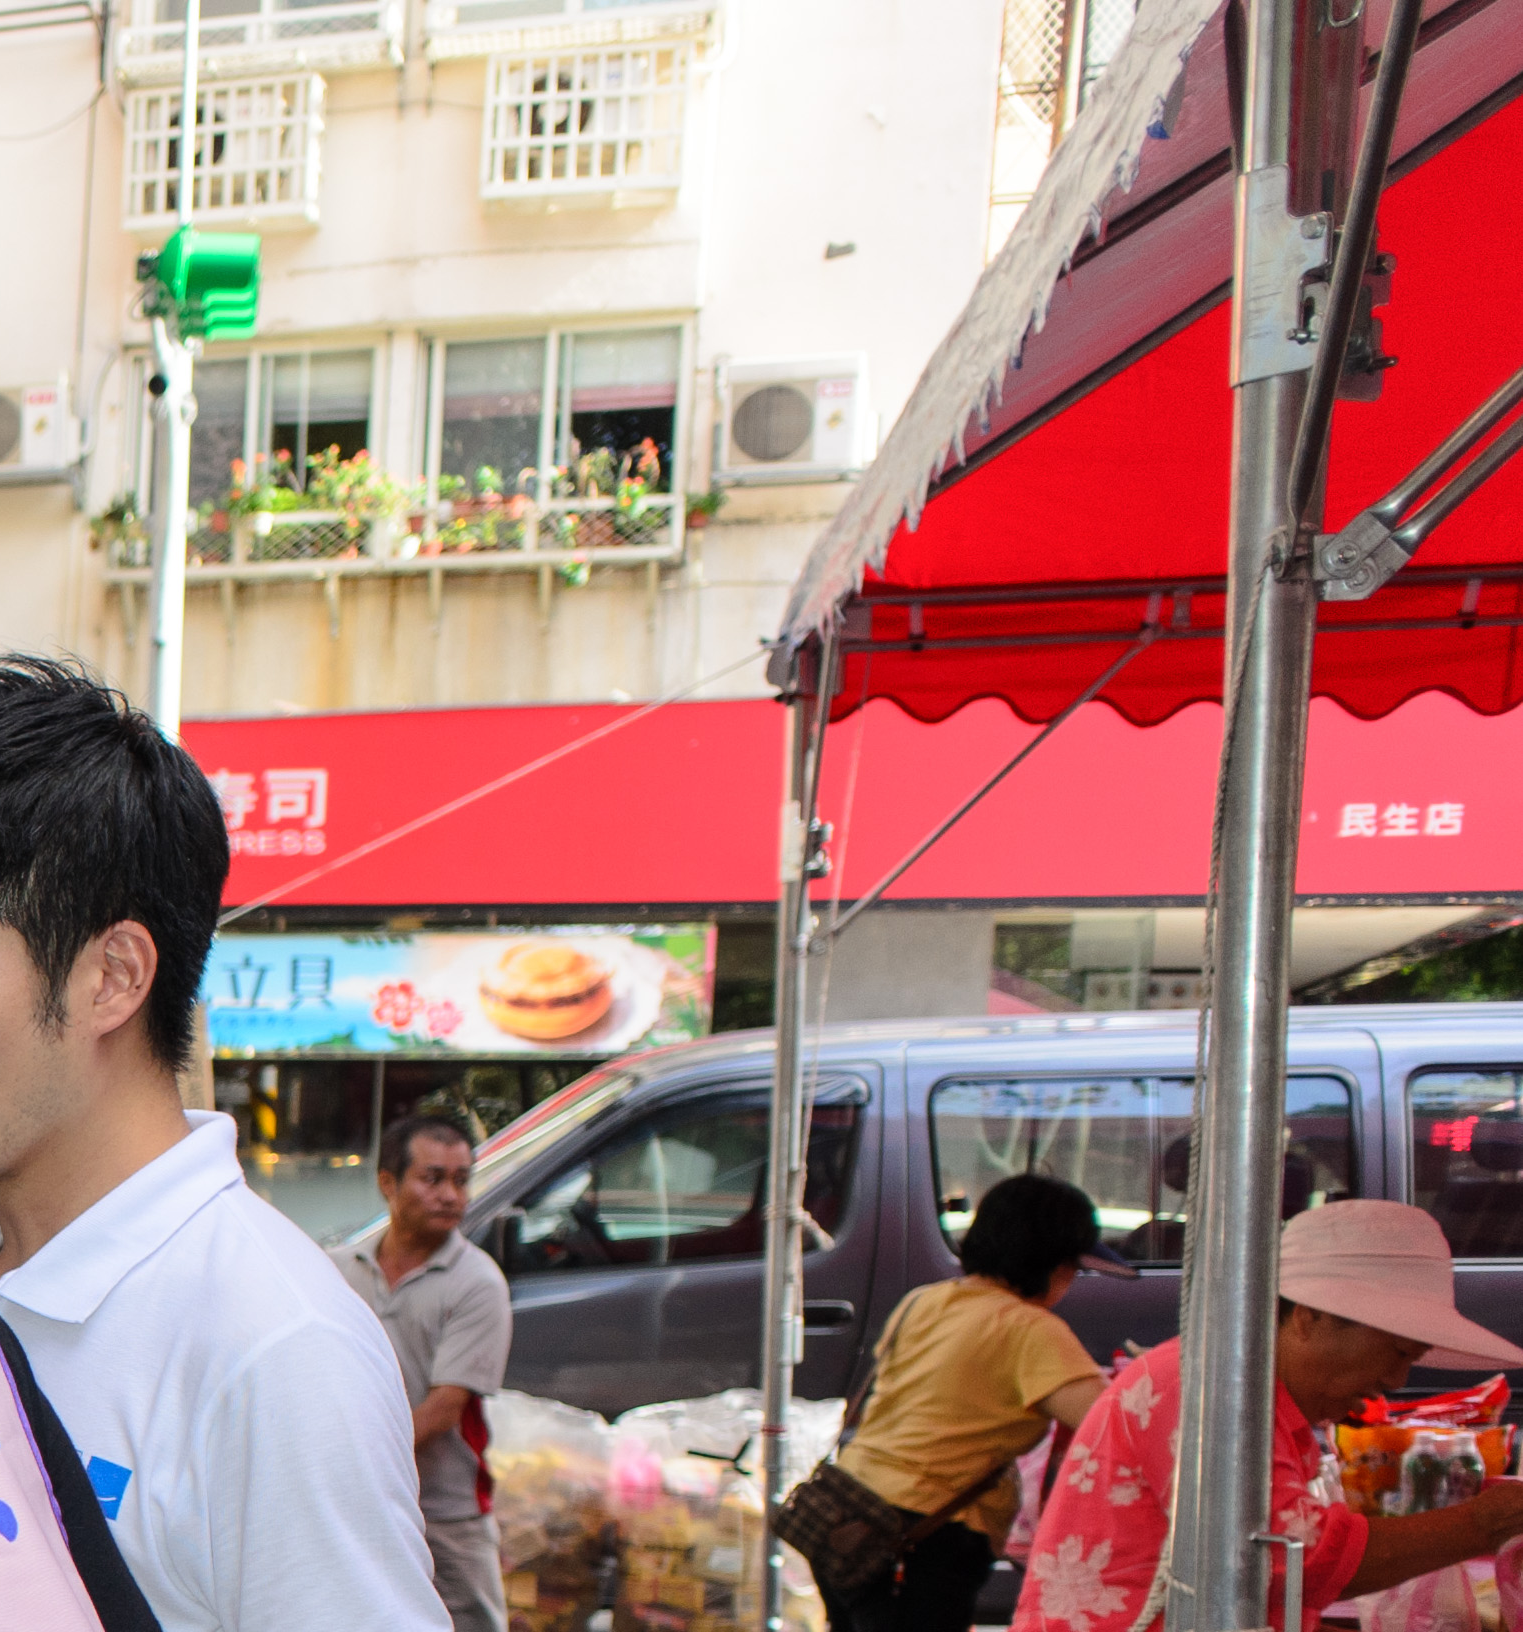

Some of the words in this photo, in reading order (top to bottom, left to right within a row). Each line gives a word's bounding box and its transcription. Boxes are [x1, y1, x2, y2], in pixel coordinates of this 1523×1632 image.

[1337, 803, 1465, 838] 民生店
[207, 953, 334, 1012] 立貝
